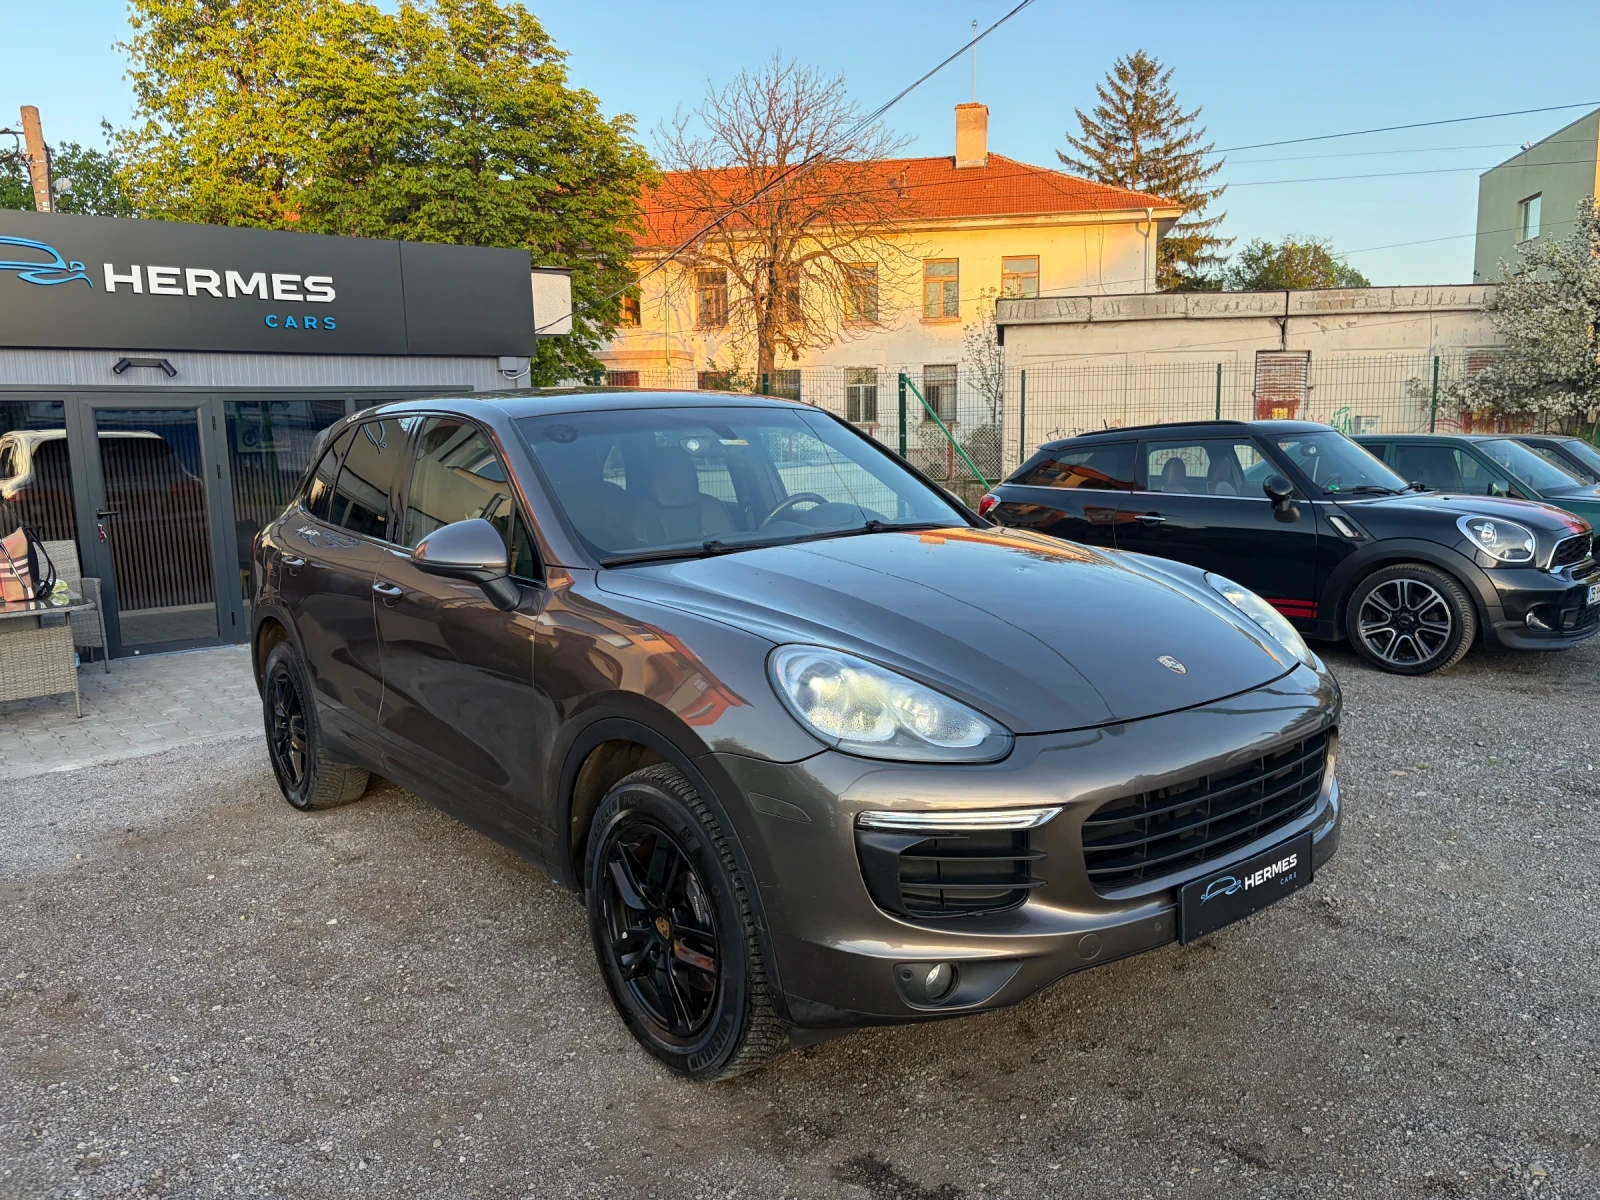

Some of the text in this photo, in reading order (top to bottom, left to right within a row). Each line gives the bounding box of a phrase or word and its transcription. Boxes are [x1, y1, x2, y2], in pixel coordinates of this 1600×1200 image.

[103, 263, 336, 303] HERMES
[265, 314, 338, 331] CARS
[623, 795, 641, 805] PILOT
[1244, 853, 1298, 890] HERMES
[1280, 871, 1297, 885] CARS
[690, 1017, 731, 1069] MICHELIN
